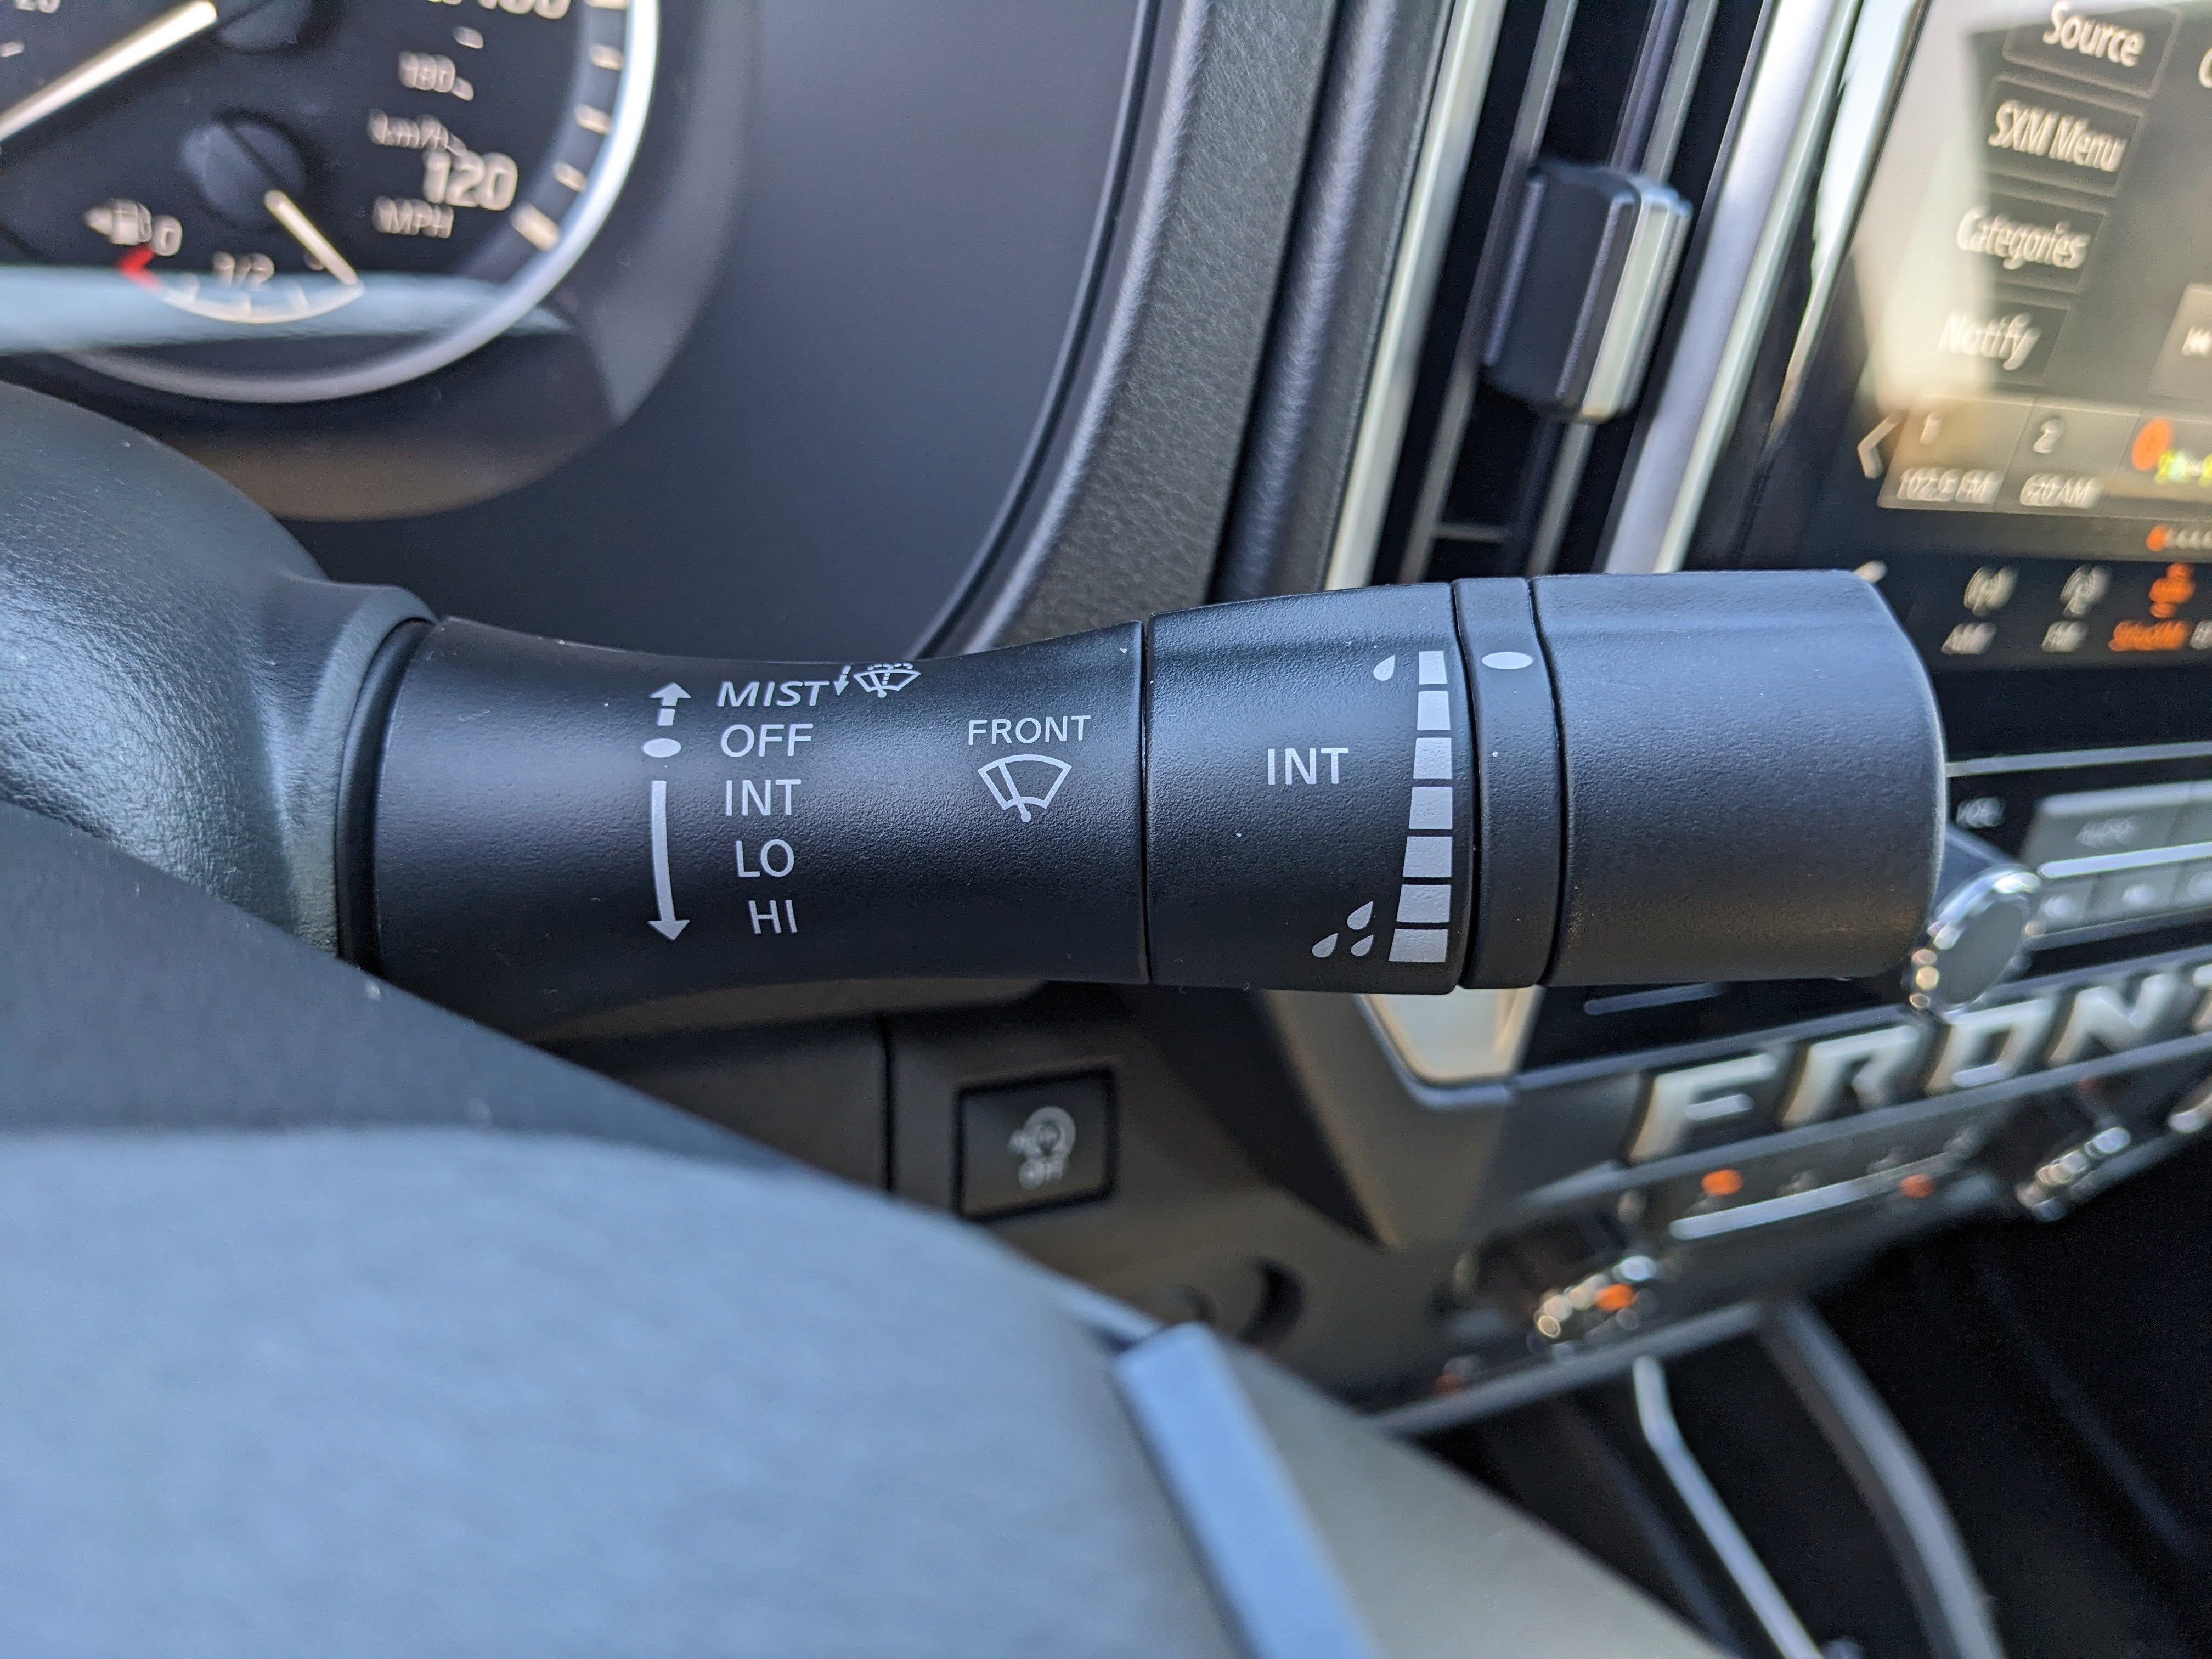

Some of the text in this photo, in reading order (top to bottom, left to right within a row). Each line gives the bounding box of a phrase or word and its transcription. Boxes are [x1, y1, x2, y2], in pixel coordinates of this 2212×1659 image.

[2043, 1, 2145, 67] Source
[1988, 99, 2126, 172] SXM Menu
[422, 150, 518, 211] 120
[373, 196, 455, 239] MPH
[1957, 206, 2090, 269] Categories
[1937, 311, 2040, 370] Notify
[717, 681, 830, 707] MIST
[721, 723, 814, 758] OFF
[968, 715, 1091, 746] FRONT
[1267, 747, 1349, 785] INT
[725, 779, 802, 816] INT
[735, 839, 794, 878] LO
[748, 900, 798, 934] HI
[1628, 963, 2212, 1163] FRON
